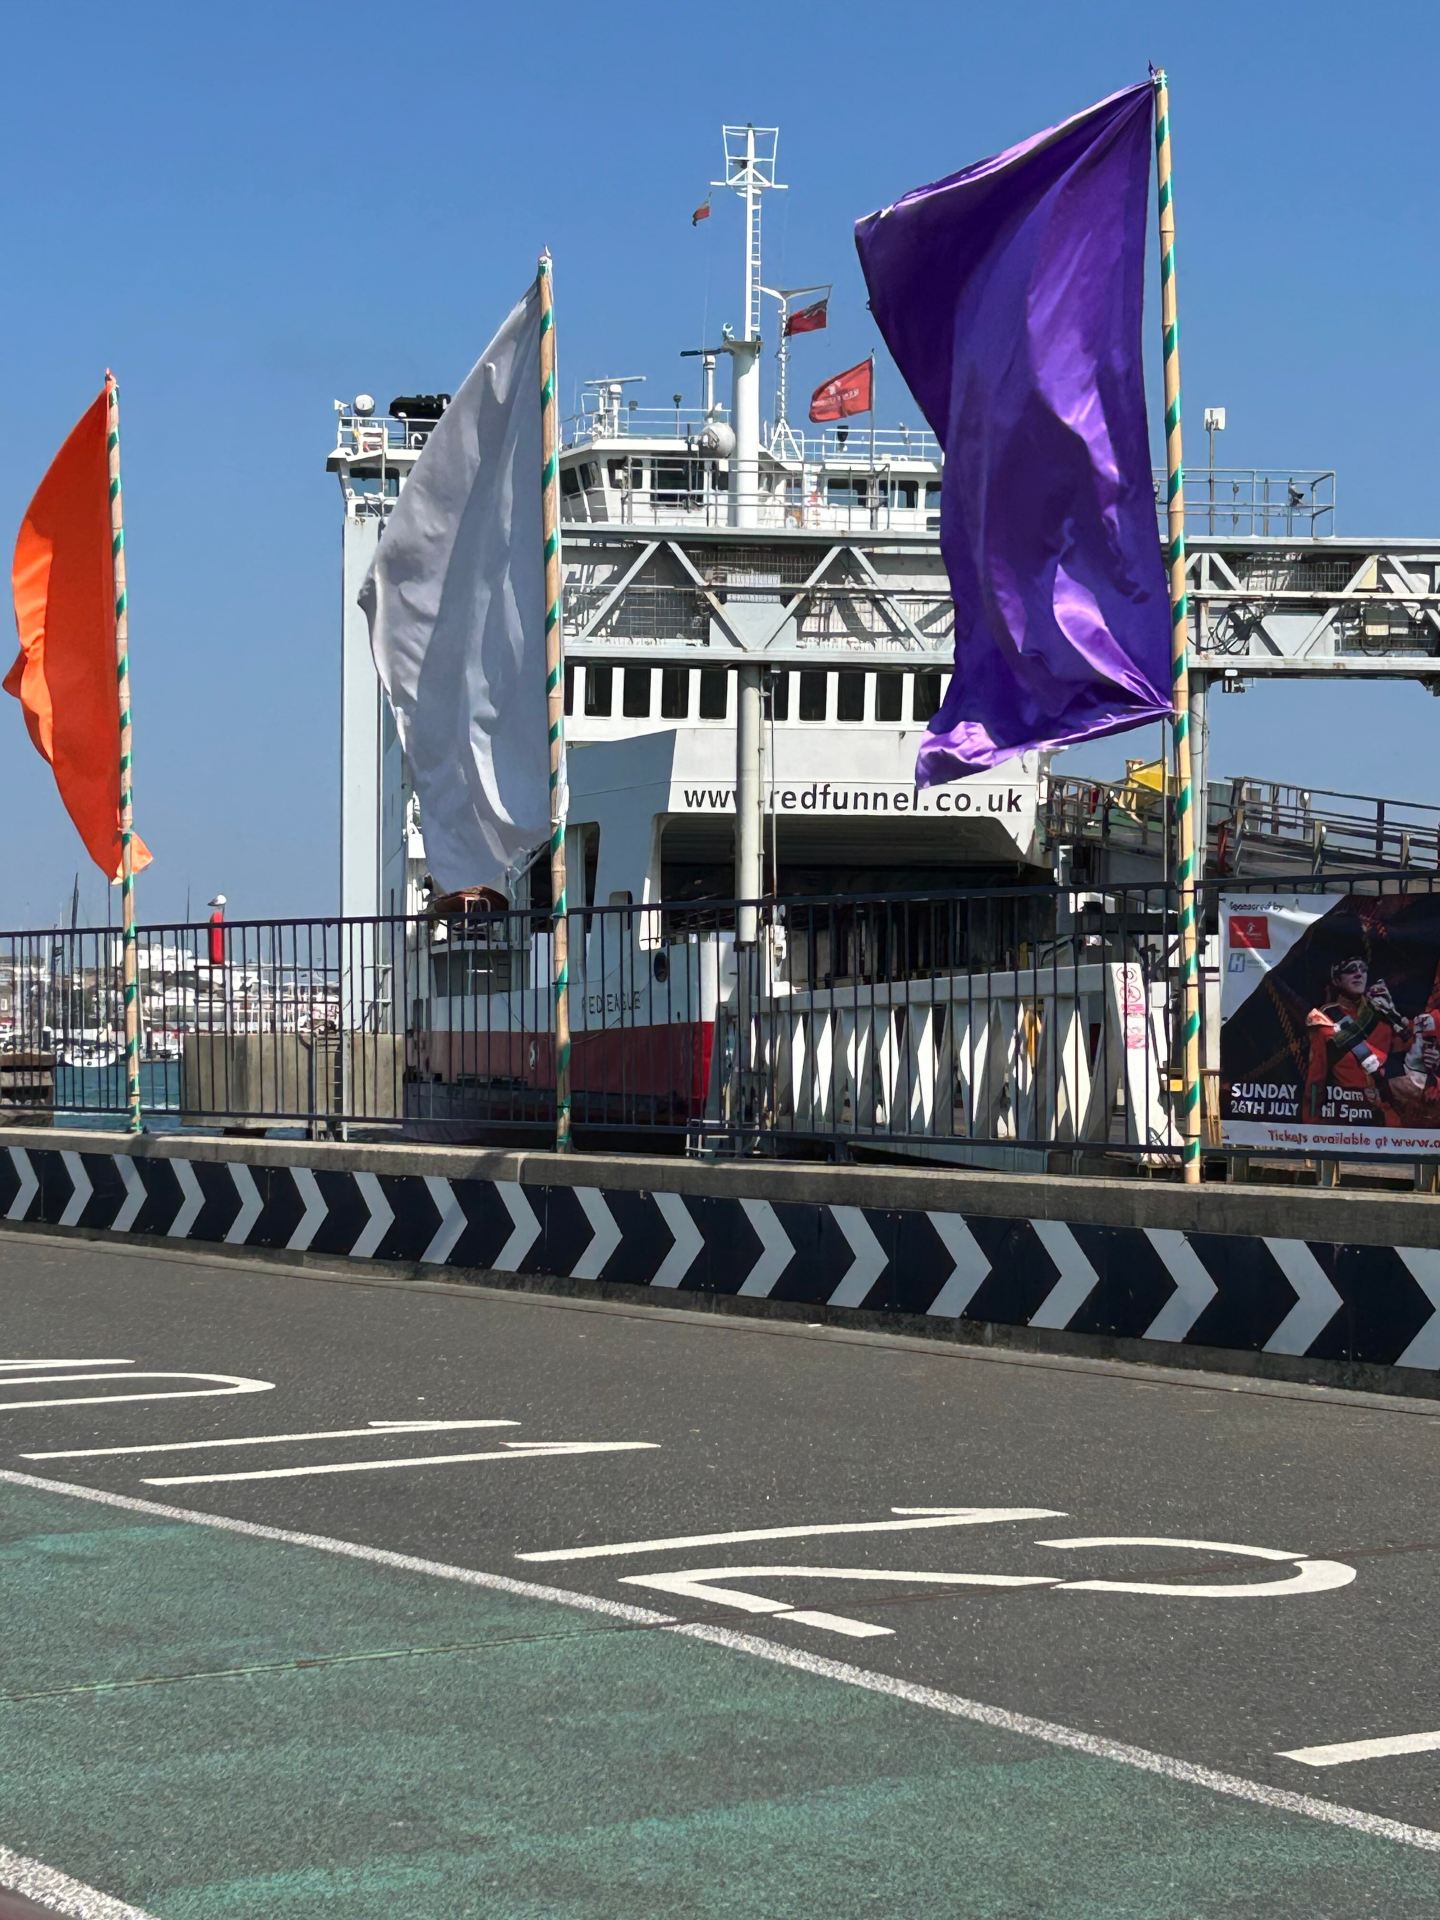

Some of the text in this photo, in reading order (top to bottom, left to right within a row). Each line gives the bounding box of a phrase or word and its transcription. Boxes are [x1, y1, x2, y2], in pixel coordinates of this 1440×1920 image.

[1231, 1083, 1298, 1099] SUNDAY
[1326, 1086, 1364, 1101] 10am
[1231, 1100, 1299, 1116] 26TH JULY
[1339, 1104, 1373, 1122] 5pm
[1268, 1129, 1308, 1145] Tickets
[1312, 1132, 1371, 1146] available
[514, 1507, 1358, 1637] 12
